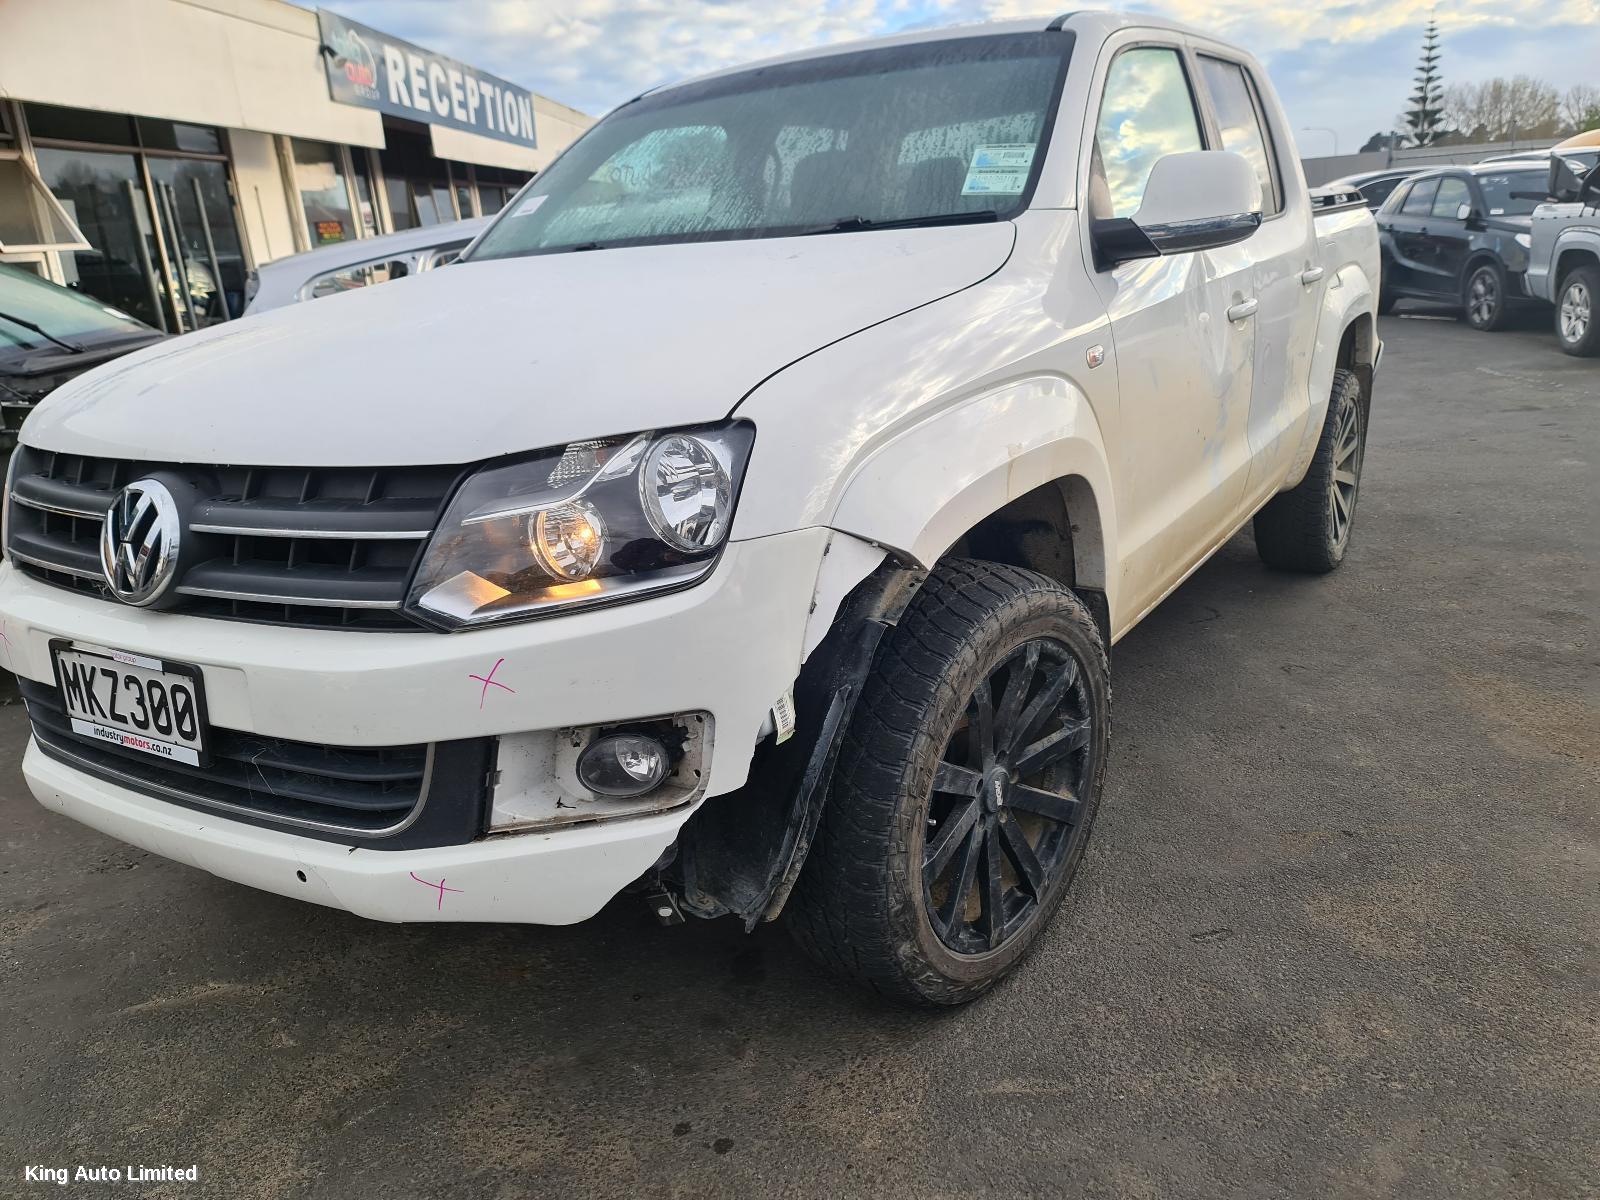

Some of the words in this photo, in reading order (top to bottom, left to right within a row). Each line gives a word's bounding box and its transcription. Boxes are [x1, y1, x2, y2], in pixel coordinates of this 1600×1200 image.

[383, 44, 534, 140] RECEPTION
[60, 658, 197, 742] MKZ300
[93, 725, 173, 756] industrymotors.co.nz
